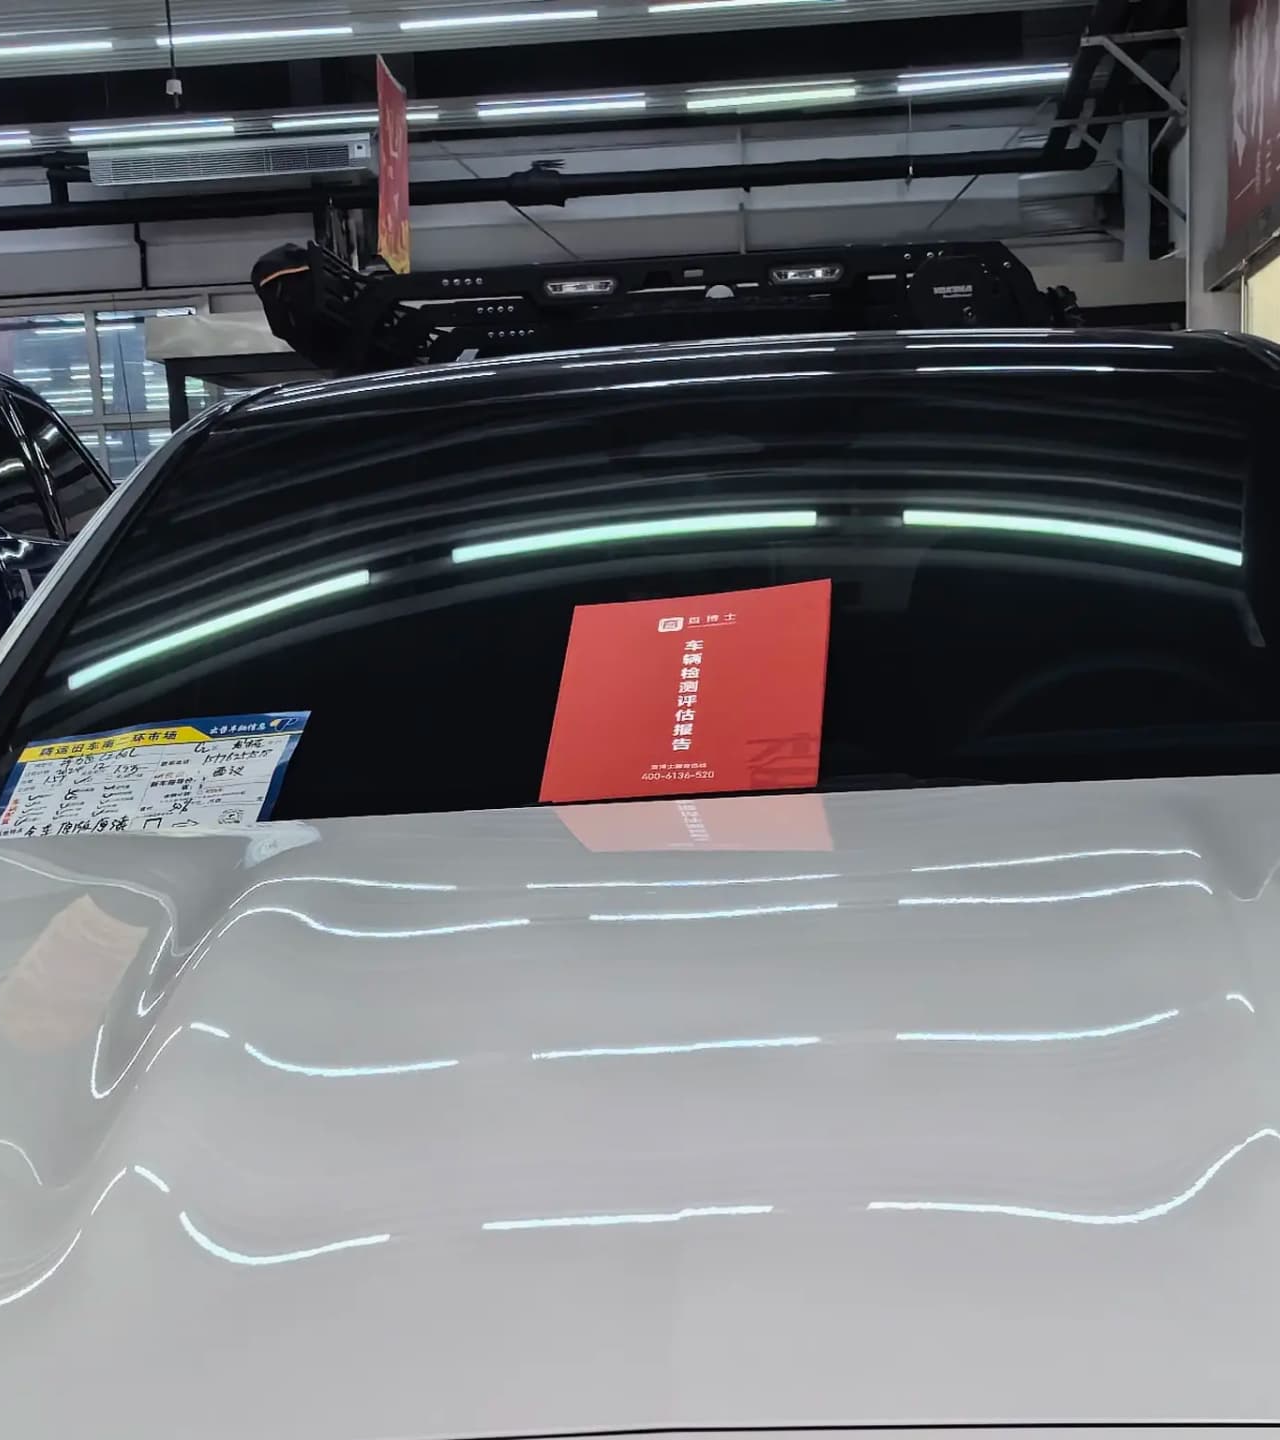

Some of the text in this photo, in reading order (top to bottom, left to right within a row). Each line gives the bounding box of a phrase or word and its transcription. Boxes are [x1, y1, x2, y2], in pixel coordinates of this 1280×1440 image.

[672, 640, 704, 751] 车辆检测评估报告
[641, 770, 715, 781] 400-6136-520
